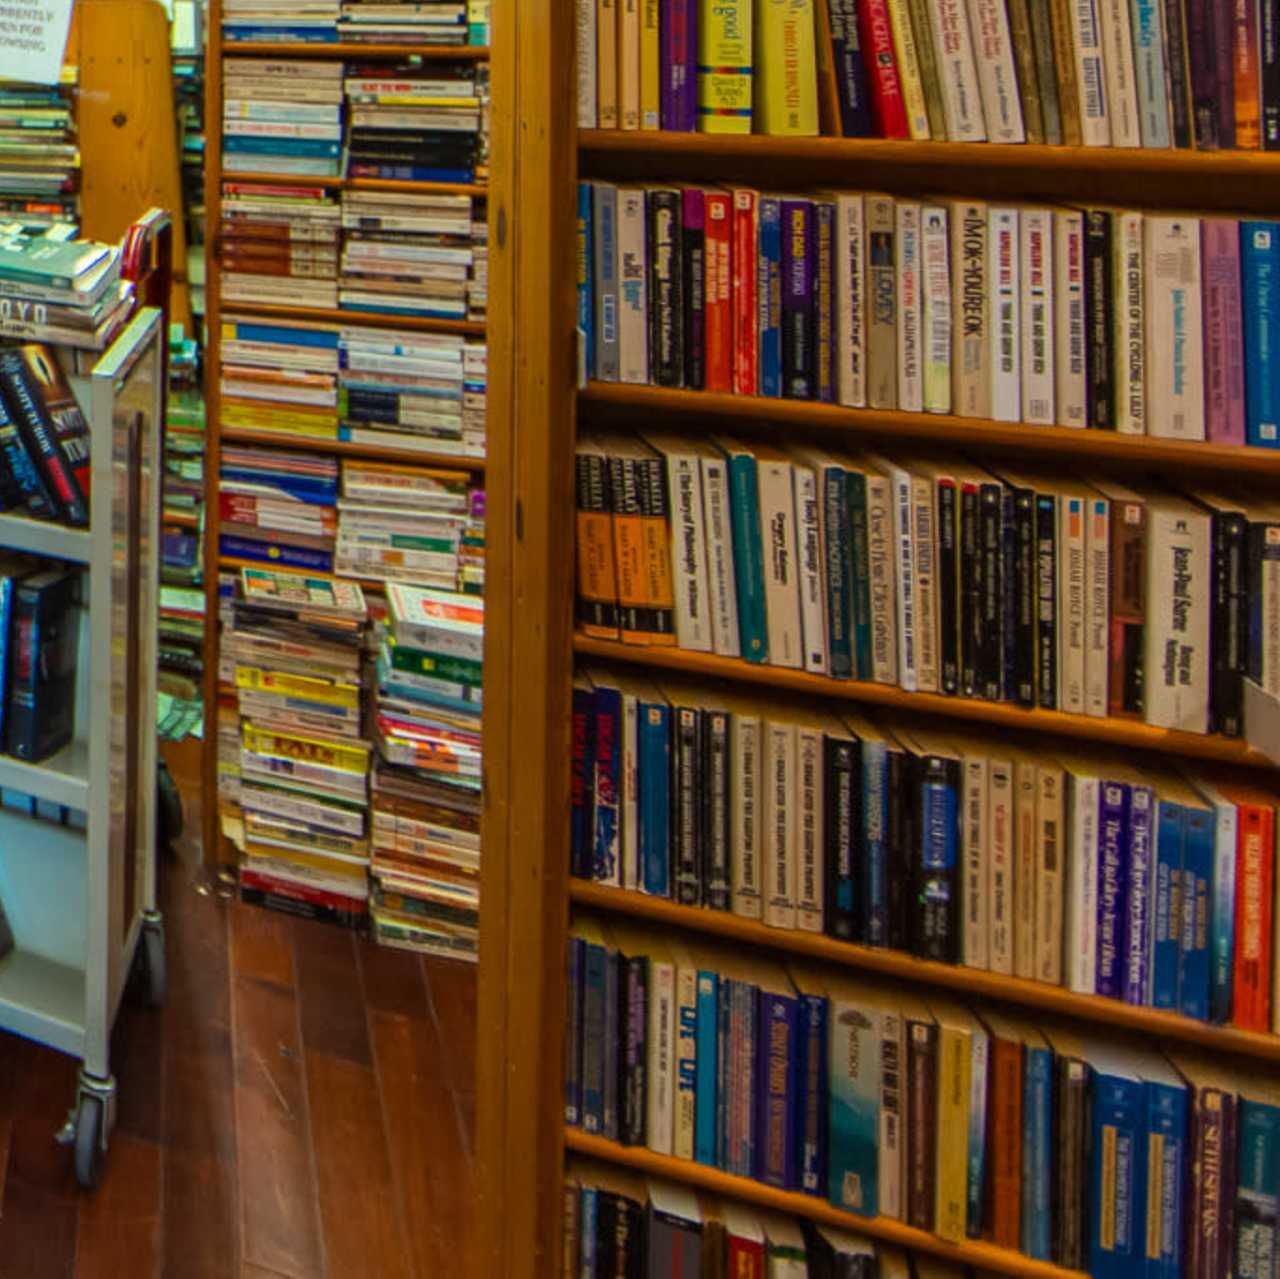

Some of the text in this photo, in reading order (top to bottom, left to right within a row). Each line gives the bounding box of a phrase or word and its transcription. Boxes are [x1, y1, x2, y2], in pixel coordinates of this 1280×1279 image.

[20, 23, 44, 36] FOR
[714, 8, 741, 39] good
[876, 269, 893, 326] LOVEY
